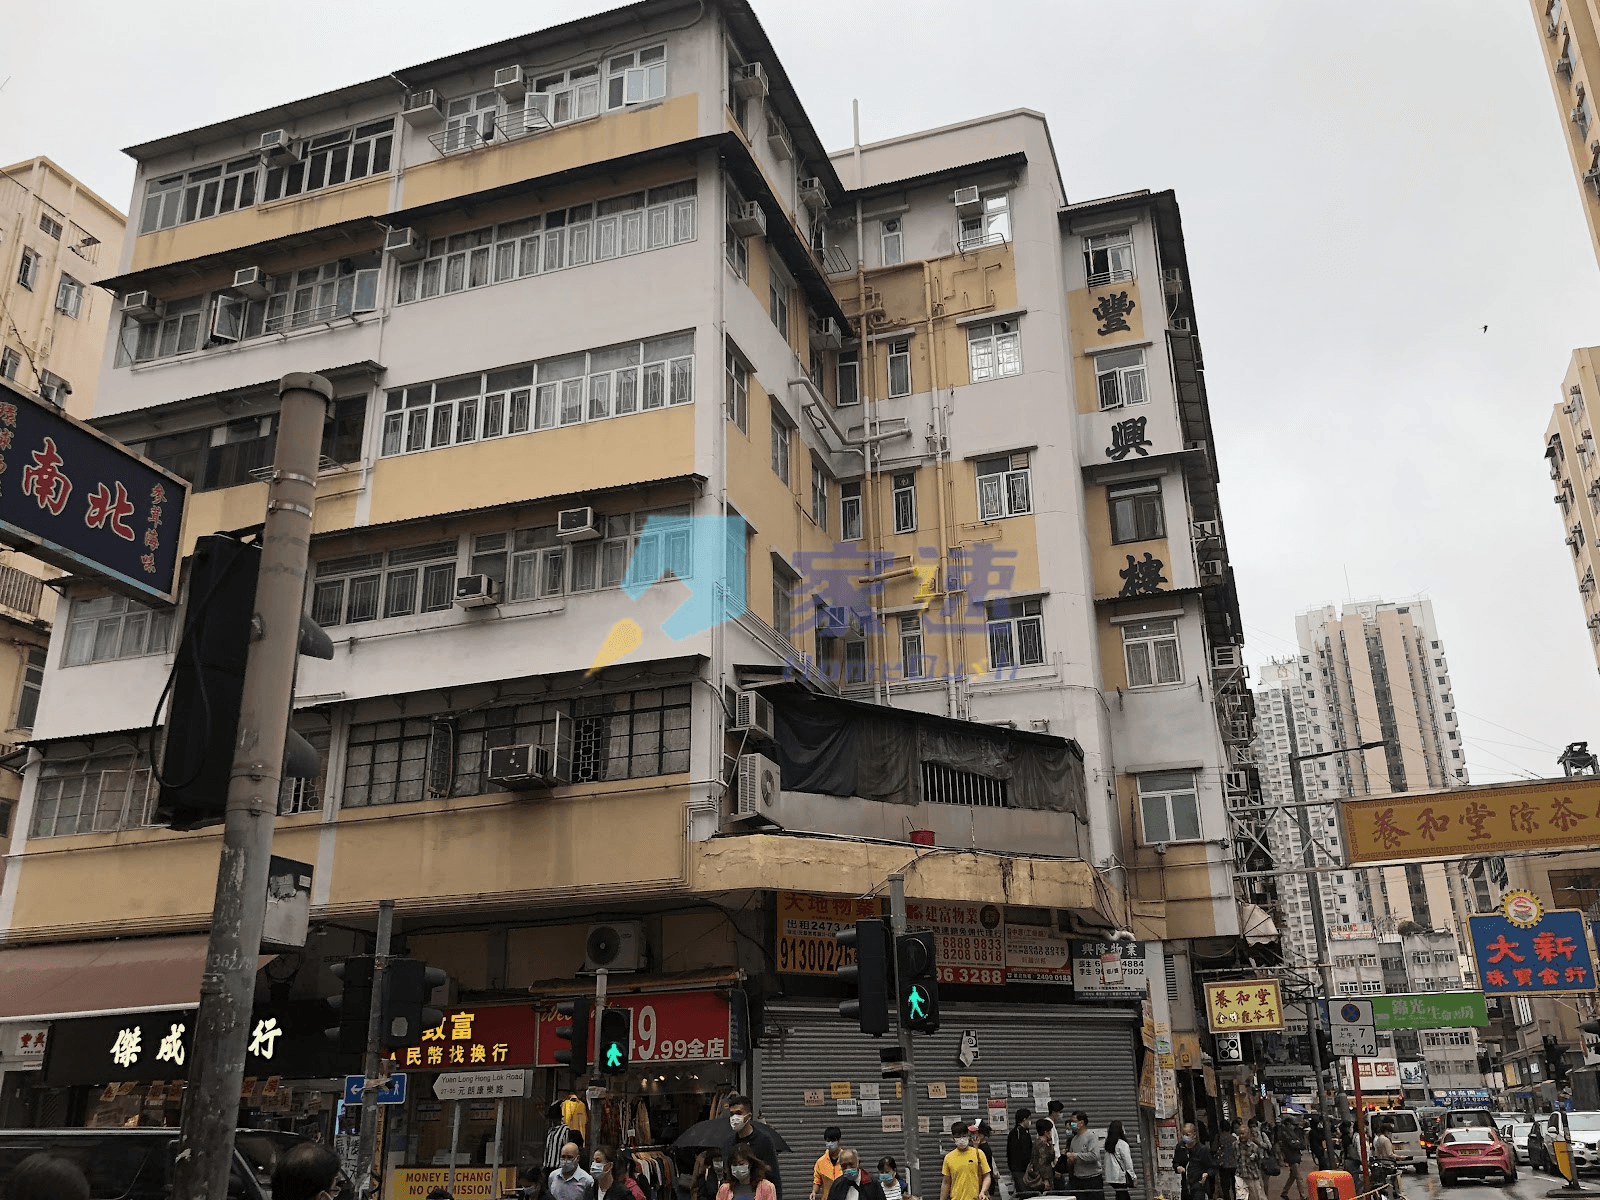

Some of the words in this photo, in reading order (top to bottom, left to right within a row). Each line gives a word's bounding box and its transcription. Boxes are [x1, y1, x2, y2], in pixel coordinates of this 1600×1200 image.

[925, 905, 977, 924] 建富物業
[943, 937, 970, 948] 6888
[973, 939, 1001, 950] 9833
[1486, 931, 1577, 965] 大新
[943, 948, 970, 960] 8208
[974, 950, 1002, 961] 0818
[959, 969, 1002, 984] 3288
[1215, 988, 1271, 1009] 養和堂
[1358, 1028, 1366, 1037] 7
[1361, 1044, 1374, 1054] 12
[458, 1075, 474, 1083] Long
[492, 1073, 504, 1081] Lok
[506, 1072, 523, 1080] Road
[406, 1172, 441, 1182] MONEY
[409, 1185, 424, 1195] NO
